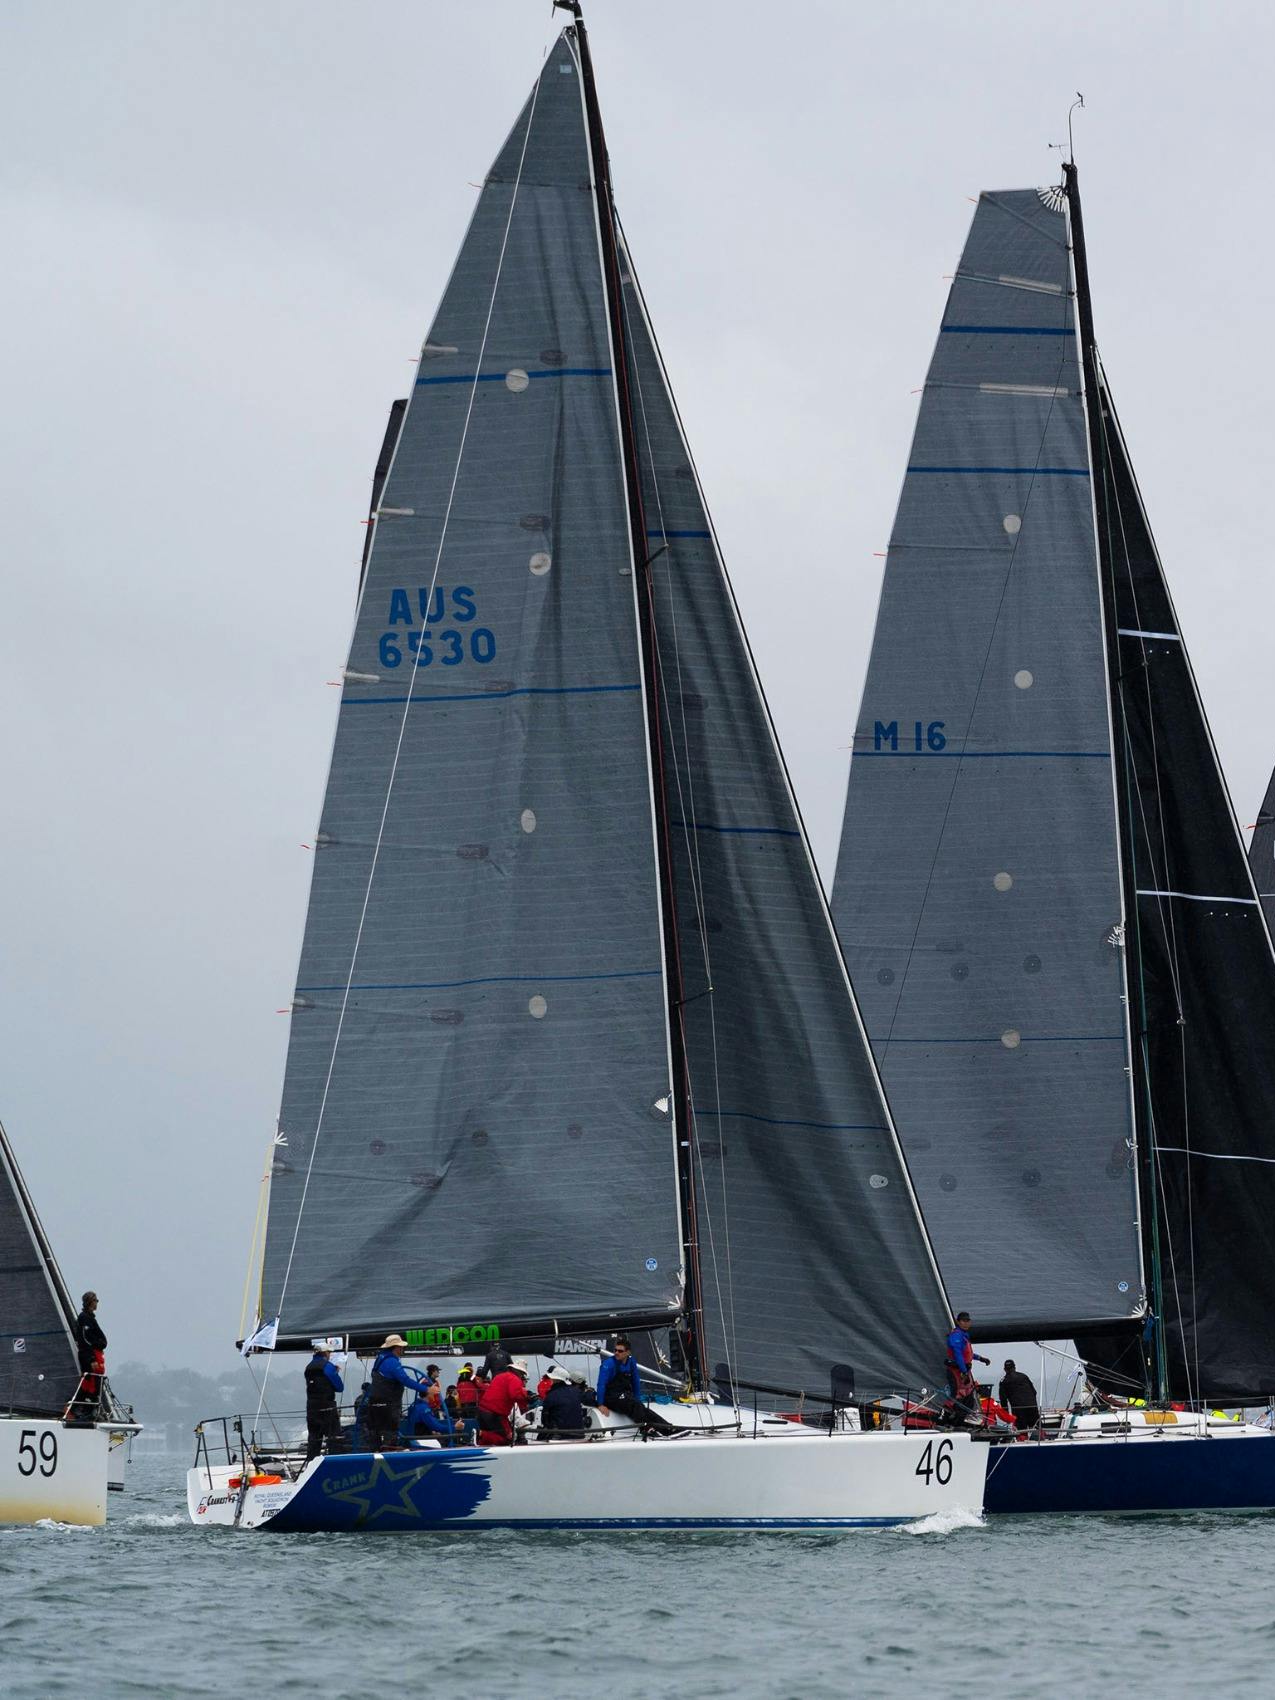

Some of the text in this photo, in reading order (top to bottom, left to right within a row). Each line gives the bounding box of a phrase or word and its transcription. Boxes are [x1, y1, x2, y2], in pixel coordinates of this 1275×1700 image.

[388, 586, 477, 625] AUS
[379, 628, 496, 668] 6530
[874, 720, 946, 751] M 16
[406, 1324, 500, 1346] WEDCON
[18, 1430, 58, 1477] 59
[915, 1439, 954, 1485] 46
